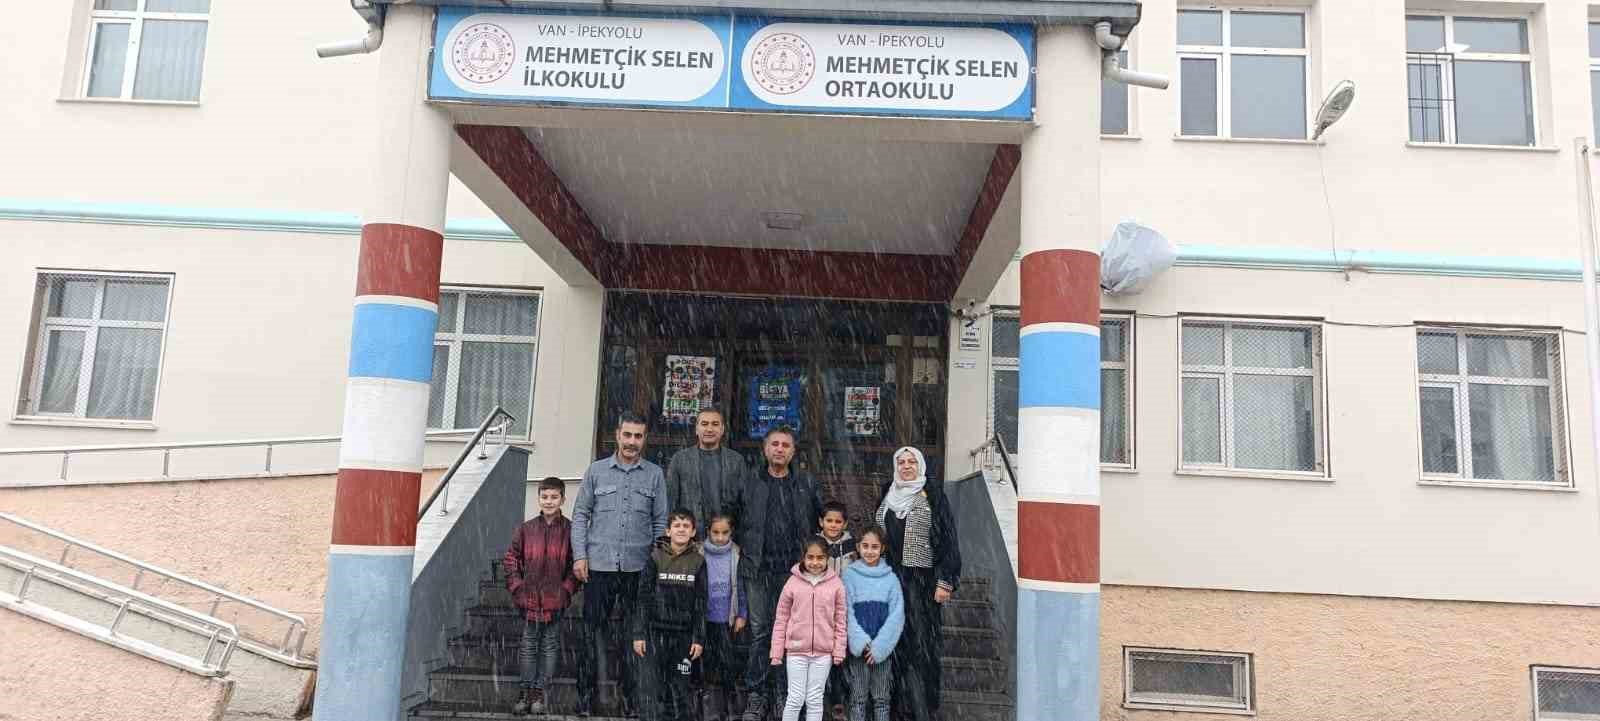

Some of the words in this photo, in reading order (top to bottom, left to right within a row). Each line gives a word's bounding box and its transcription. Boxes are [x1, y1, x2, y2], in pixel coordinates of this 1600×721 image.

[538, 23, 566, 37] VAN
[577, 22, 643, 39] İPEKYOLU
[838, 33, 866, 48] VAN
[878, 32, 945, 49] İPEKYOLU
[525, 45, 647, 70] MEHMETÇİK
[651, 50, 713, 69] SELEN
[826, 55, 950, 79] MEHMETÇİK
[954, 60, 1018, 78] SELEN
[523, 65, 625, 89] İLKOKULU
[825, 80, 954, 100] ORTAOKULU
